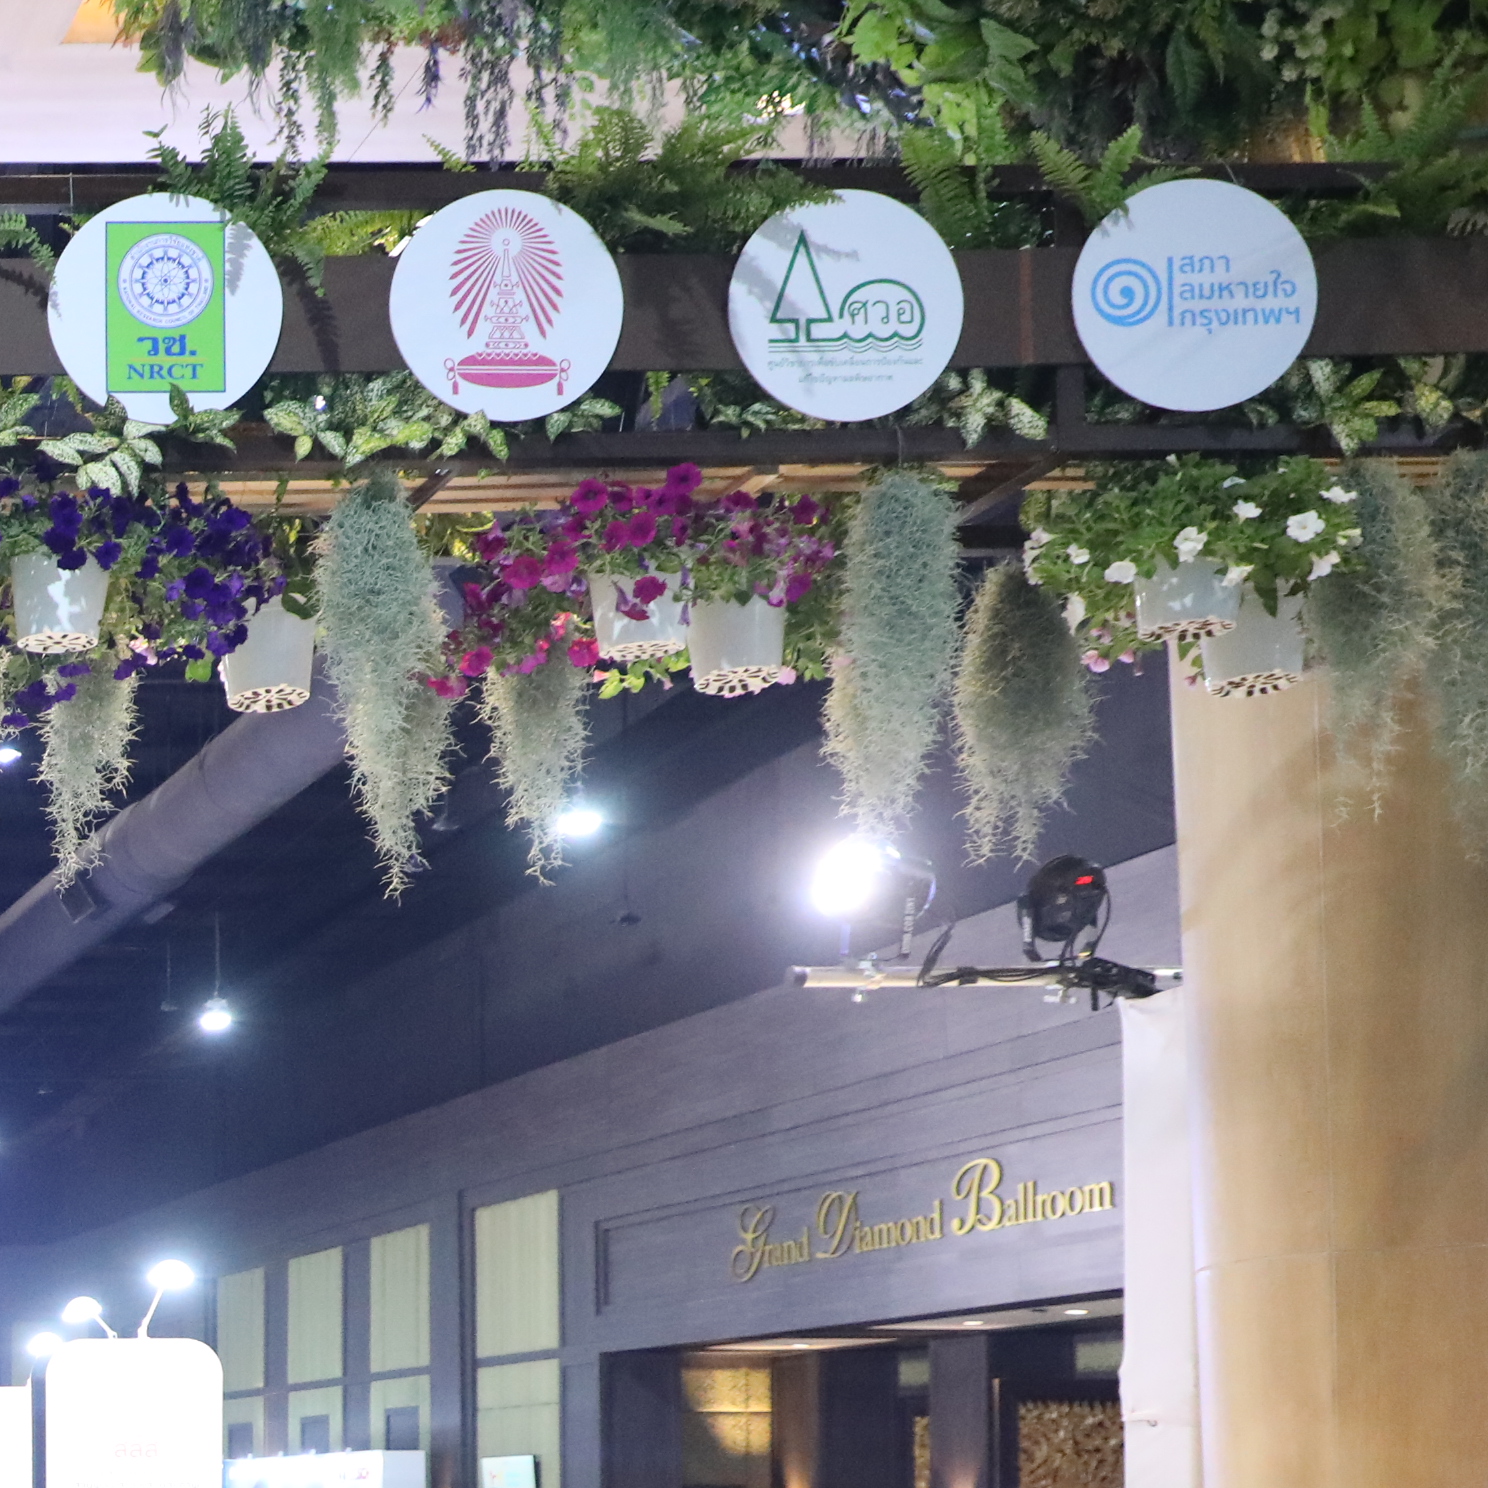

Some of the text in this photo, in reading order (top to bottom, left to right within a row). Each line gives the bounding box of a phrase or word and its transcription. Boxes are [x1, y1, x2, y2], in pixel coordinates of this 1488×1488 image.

[1179, 255, 1231, 274] สภา
[1179, 270, 1297, 301] ลมหายใจ
[847, 299, 914, 325] ศวอ
[1179, 306, 1300, 334] กรุงเทพฯ
[137, 334, 197, 357] วช.
[126, 363, 204, 380] NRCT
[731, 1157, 1113, 1282] Grand Diamond Ballroom
